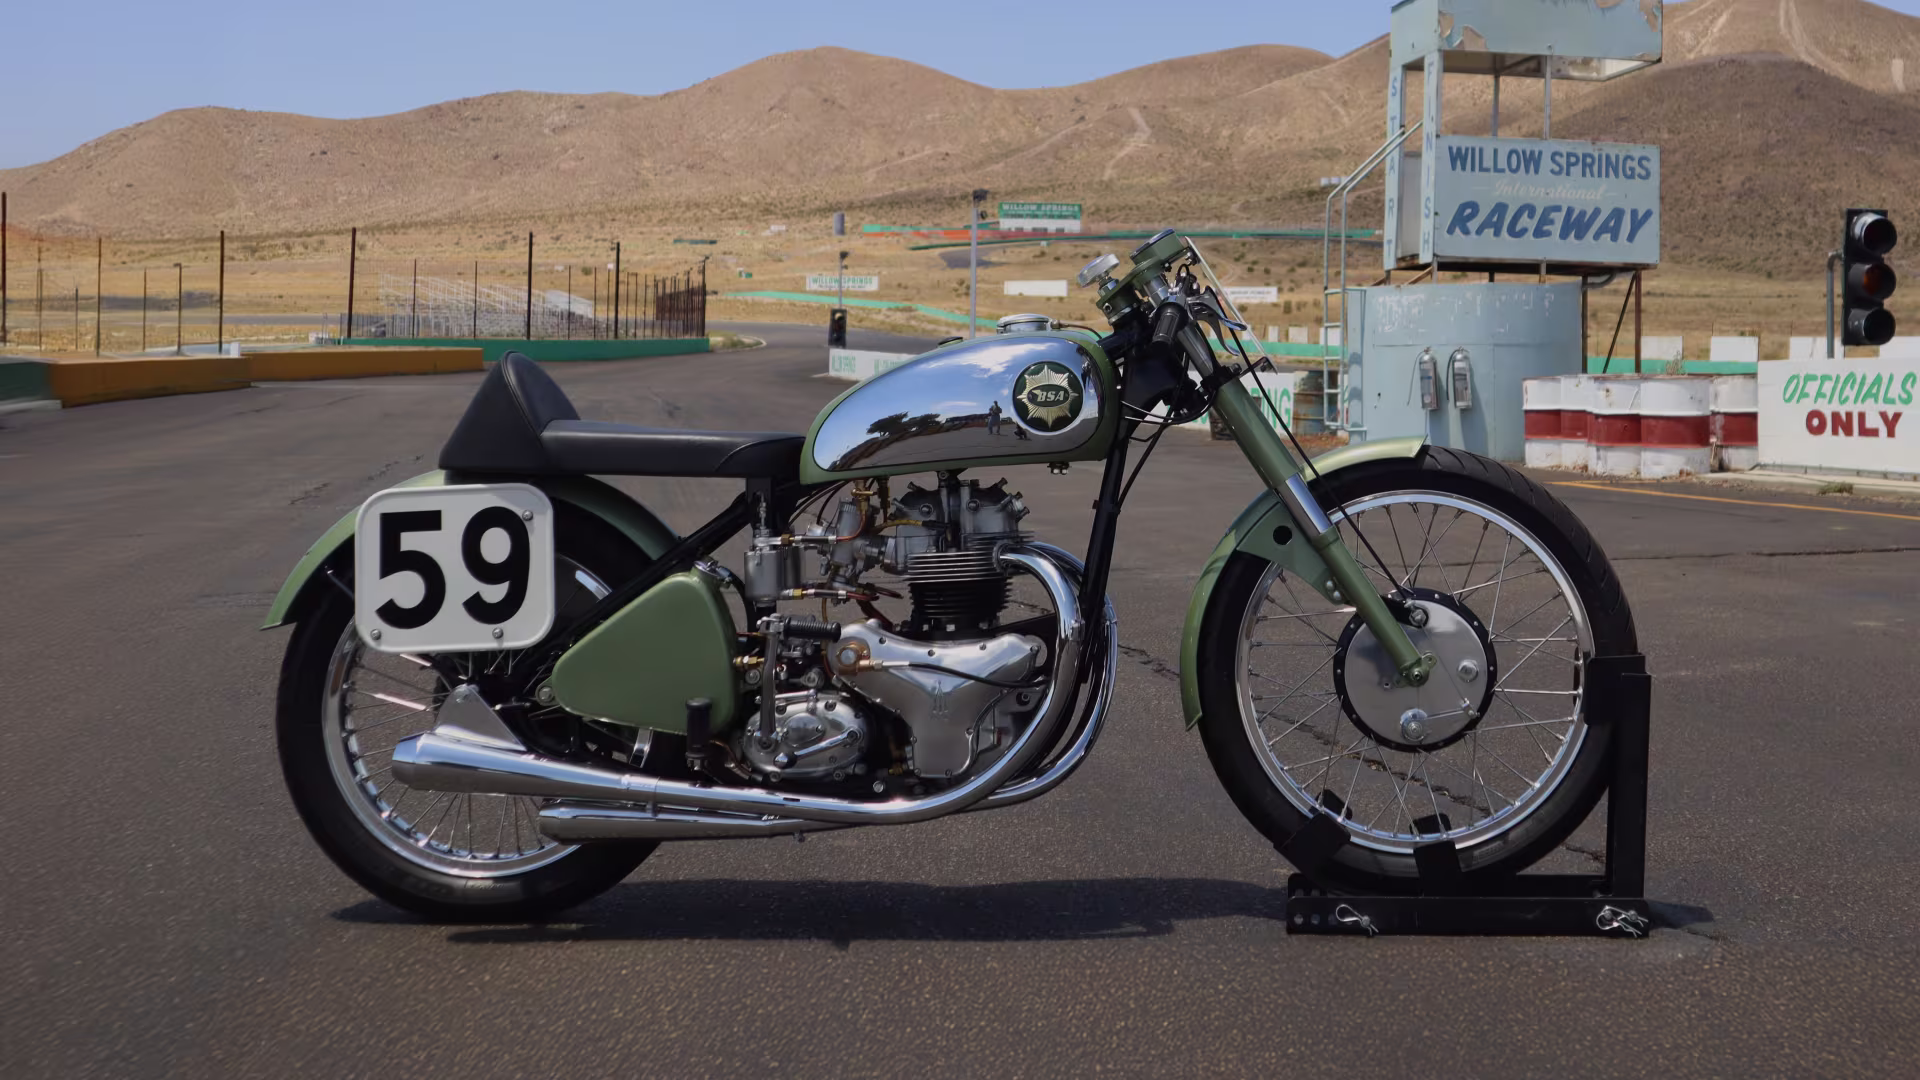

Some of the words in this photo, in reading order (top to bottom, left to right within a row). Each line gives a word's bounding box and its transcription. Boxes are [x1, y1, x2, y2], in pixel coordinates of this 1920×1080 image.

[1386, 76, 1398, 258] START
[1422, 62, 1435, 254] FINISH
[1448, 145, 1543, 175] WILLOW
[1550, 151, 1652, 180] SPRINGS
[1494, 180, 1607, 200] International
[1446, 200, 1653, 243] RACEWAY
[1033, 390, 1065, 402] BSA
[1782, 371, 1917, 405] OFFICIALS
[1806, 409, 1903, 438] ONLY
[375, 506, 531, 629] 59
